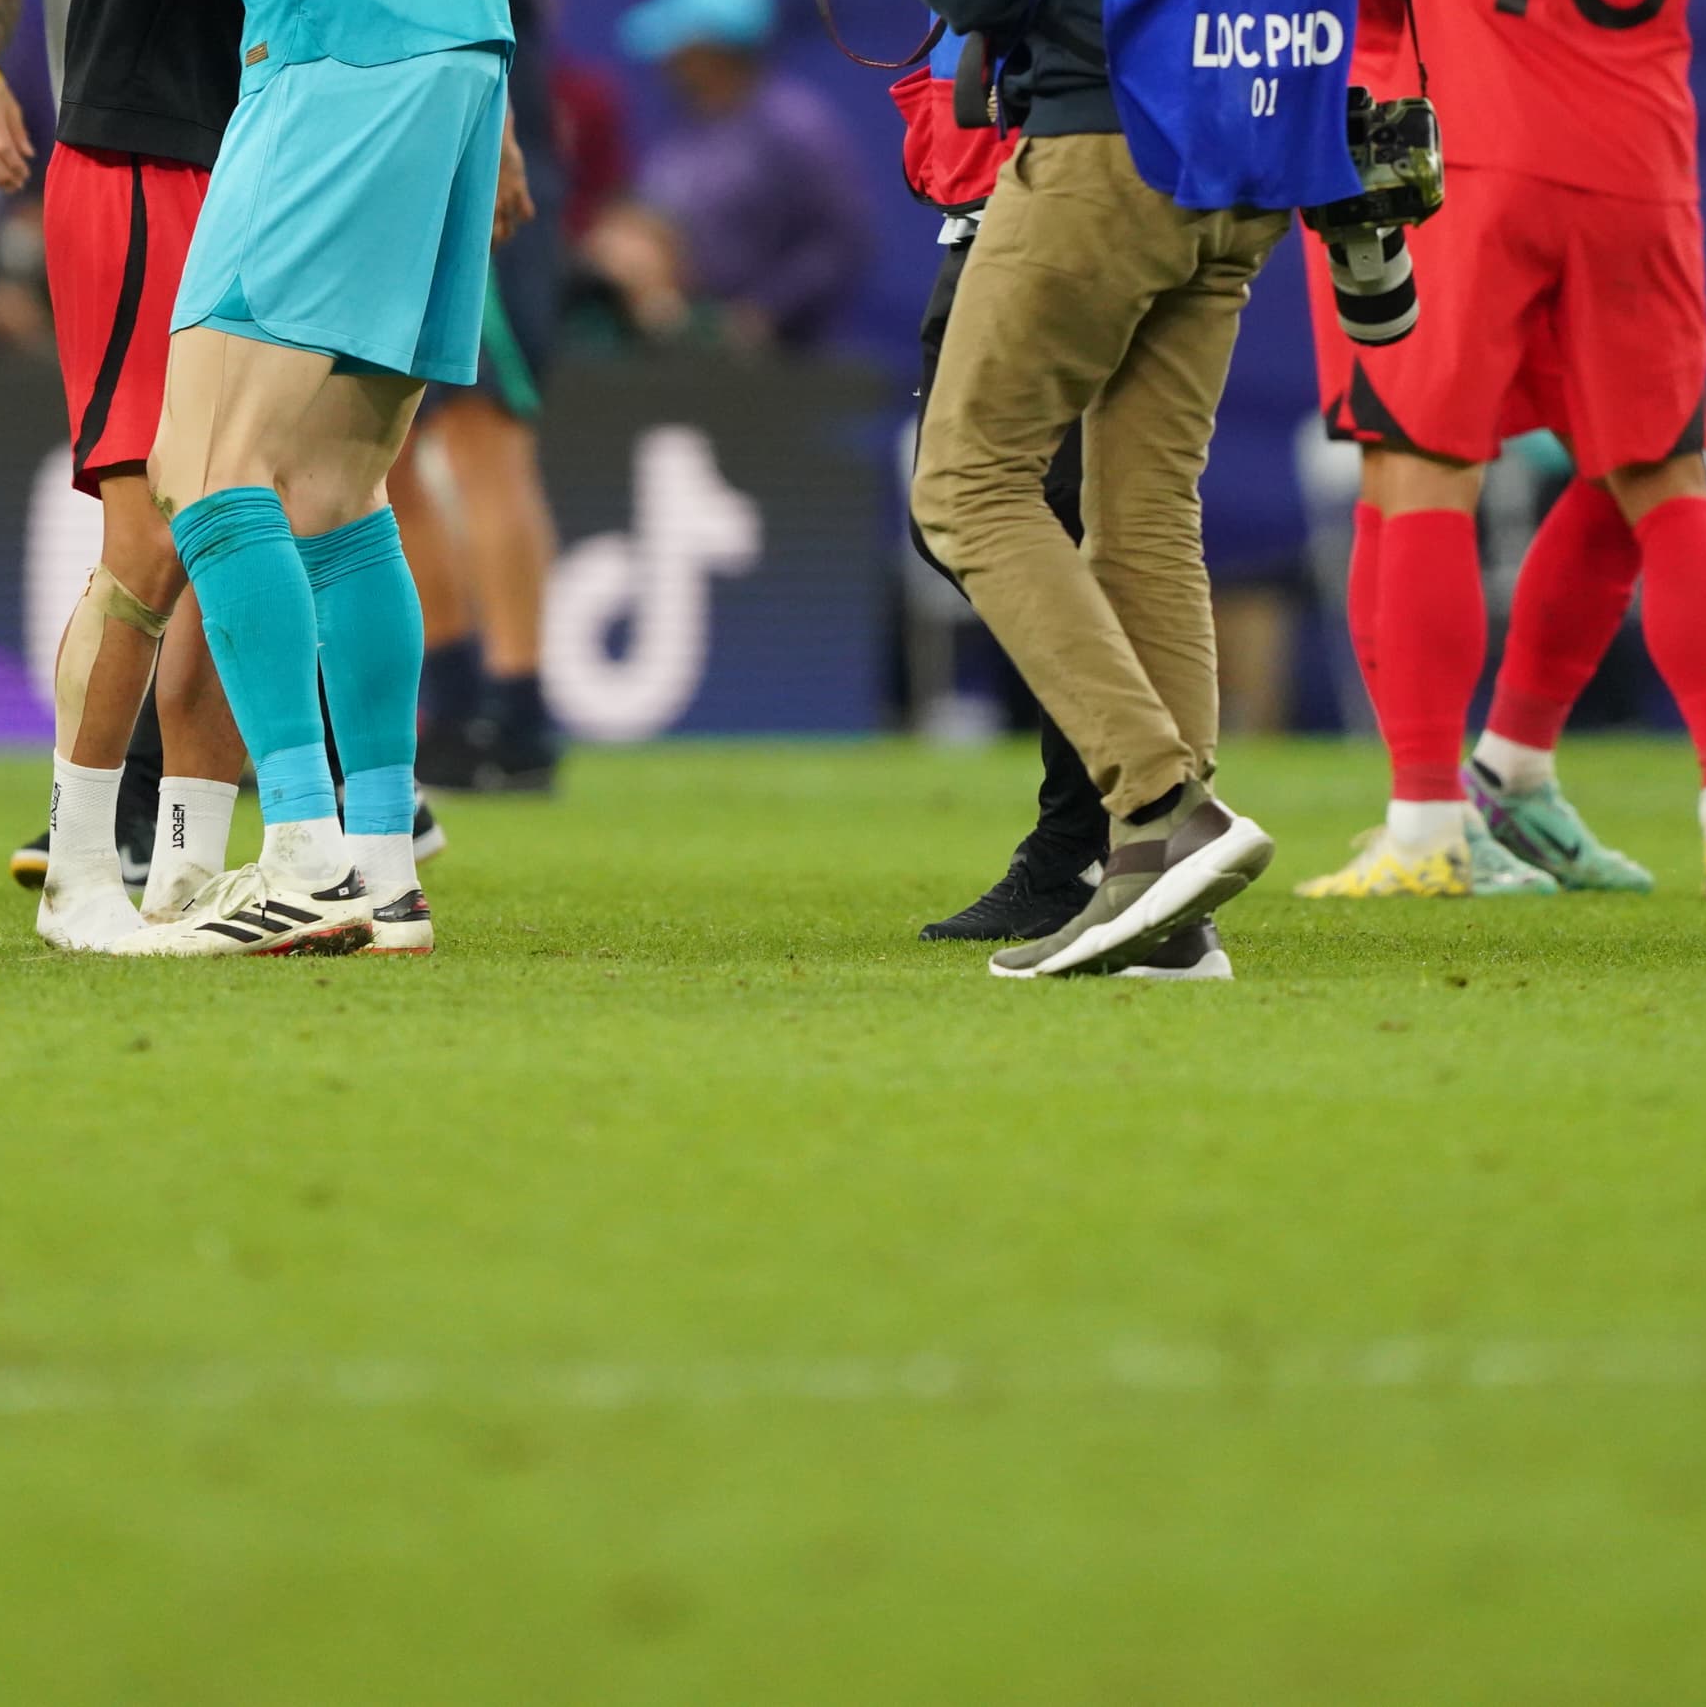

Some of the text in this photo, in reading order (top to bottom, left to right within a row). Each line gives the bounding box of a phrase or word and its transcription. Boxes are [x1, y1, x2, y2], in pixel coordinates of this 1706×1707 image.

[1193, 10, 1344, 69] LOC PHO
[1251, 77, 1279, 118] 01
